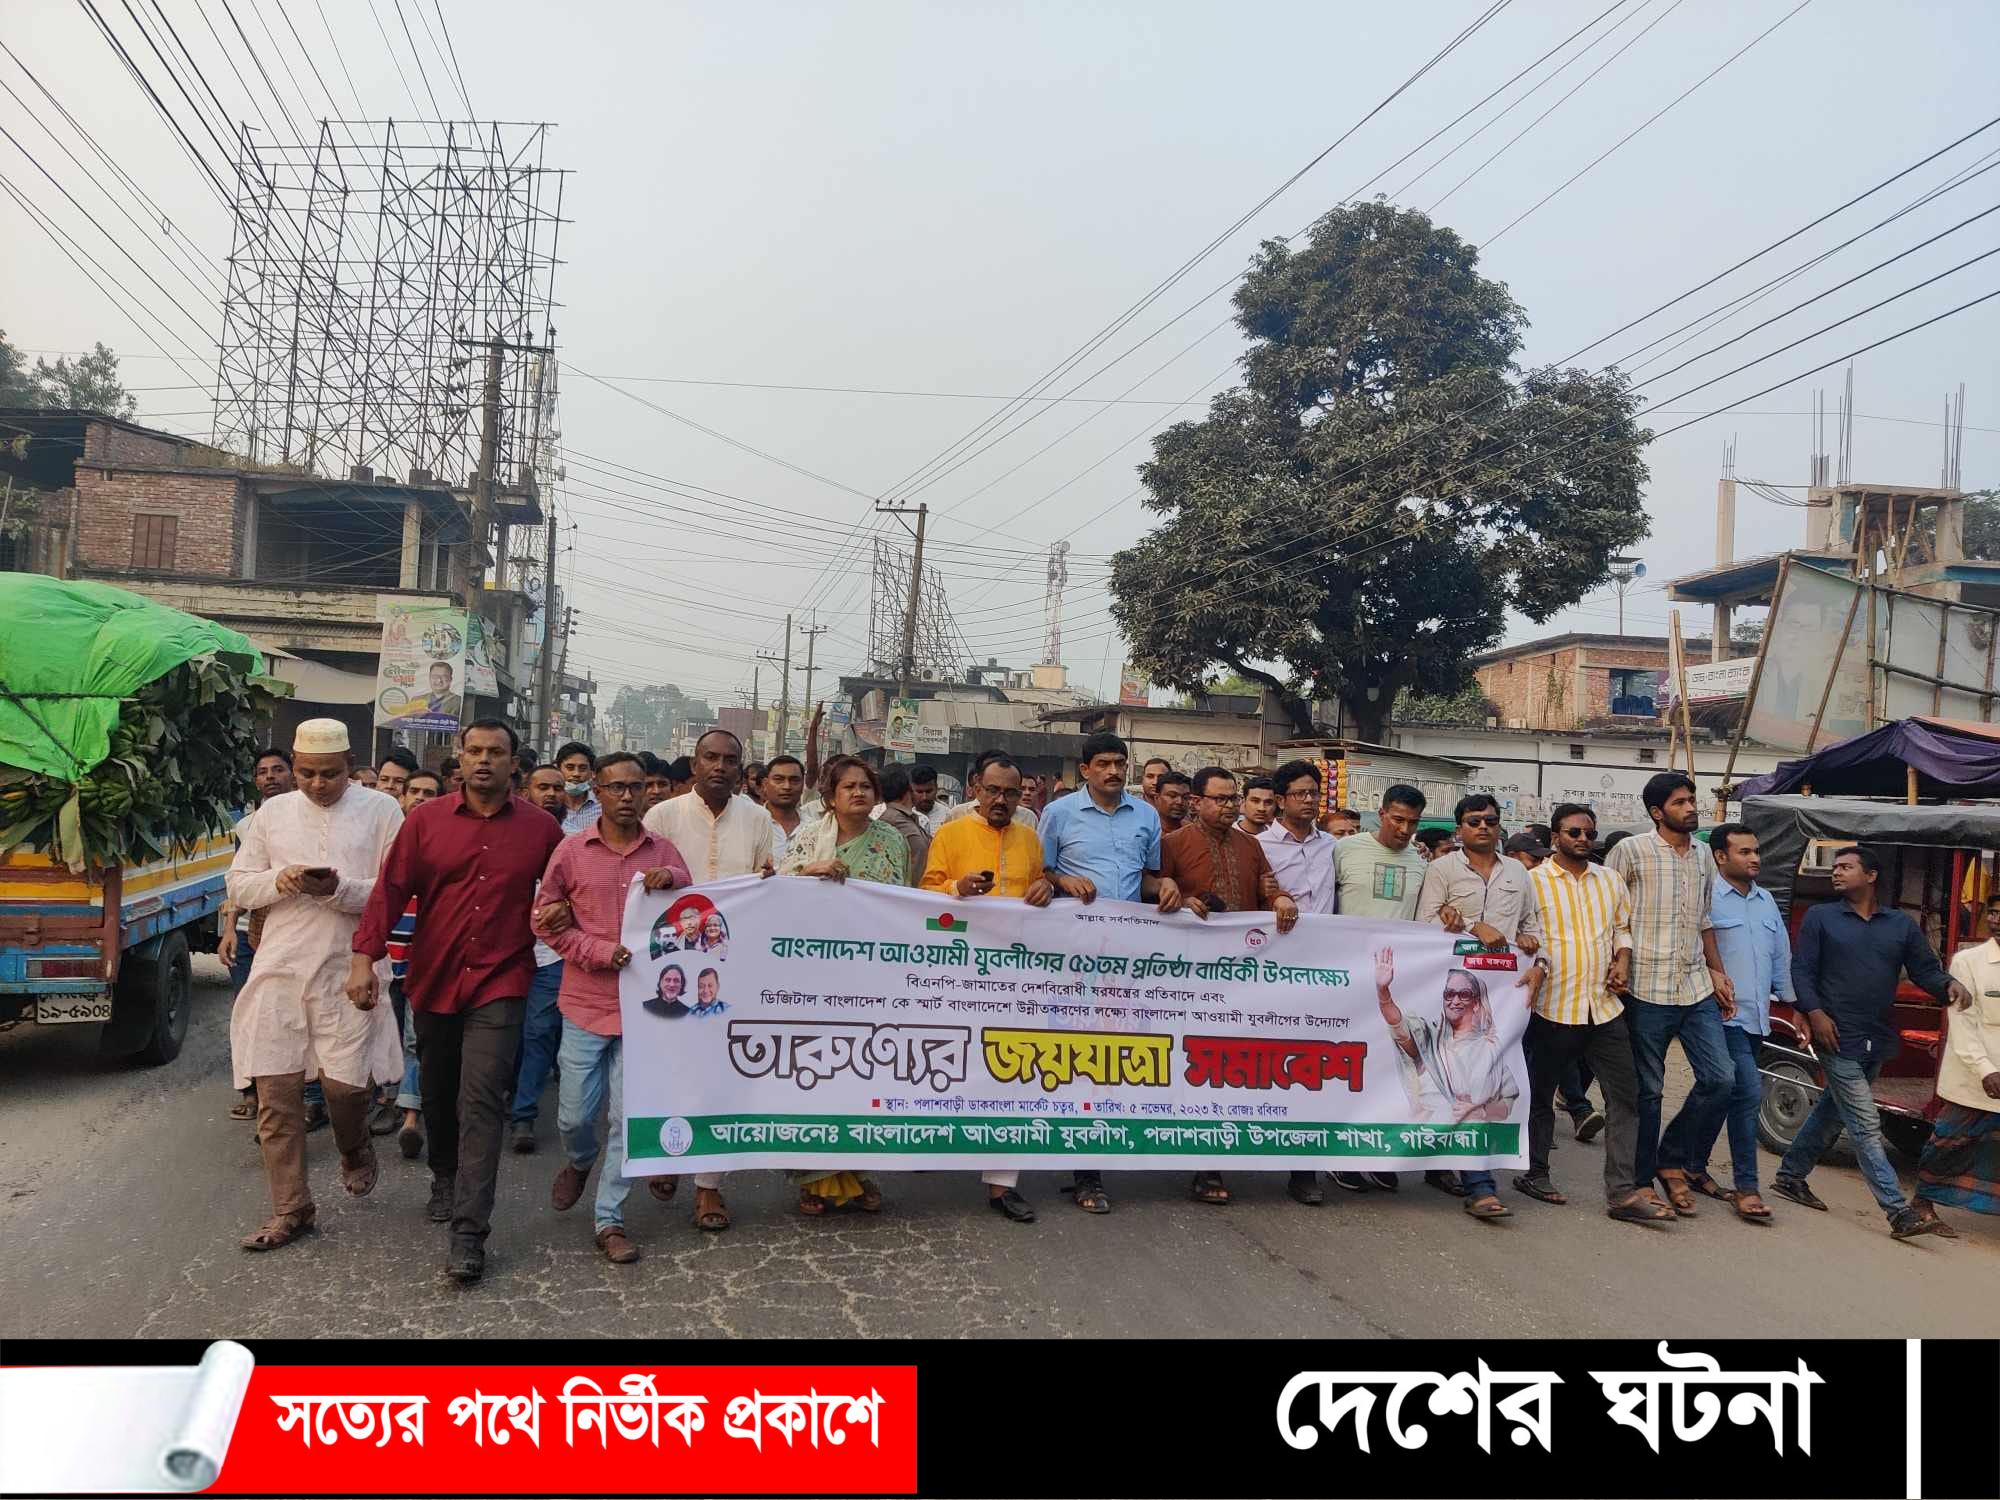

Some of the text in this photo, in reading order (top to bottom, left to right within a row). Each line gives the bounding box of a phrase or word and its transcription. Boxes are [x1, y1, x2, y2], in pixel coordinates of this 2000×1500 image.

[1075, 913, 1105, 923] আল্লাহ
[771, 937, 1350, 987] বাংলাদেশ আওয়ামী যুবলীগের ৫১তম প্রতিষ্ঠা বার্ষিকী উপলক্ষ্যে
[906, 974, 1226, 1004] বিএনপি-জামাতের দেশবিরোধী ষরযন্ত্রের প্রতিবাদে এবং
[760, 989, 1350, 1029] ডিজিটাল বাংলাদেশ কে স্মার্ট বাংলাদেশে উন্নীতকরণের লক্ষ্যে বাংলাদেশ আওয়ামী যুবলীগের উদ্যোগে
[727, 1018, 1368, 1092] তারুণ্যের জয়যাত্রা সমাবেশ
[885, 1097, 909, 1112] স্থান:
[914, 1095, 965, 1113] পলাশবাড়ী
[968, 1098, 1015, 1111] ডাকবাংলা
[1018, 1096, 1049, 1112] মার্কেট
[1093, 1098, 1125, 1114] তারিখ:
[1129, 1103, 1137, 1114] ৫
[1141, 1102, 1176, 1116] নভেম্বর,
[1180, 1103, 1208, 1115] ২০২৩
[1212, 1102, 1223, 1115] ইং
[1257, 1103, 1289, 1116] রবিবার
[709, 1121, 839, 1146] আয়োজনেঃ
[848, 1121, 955, 1147] বাংলাদেশ
[960, 1119, 1054, 1146] আওয়ামী
[1058, 1121, 1135, 1151] যুবলীগ,
[1143, 1121, 1241, 1151] পলাশবাড়ী
[1247, 1123, 1328, 1149] উপজেলা
[1336, 1125, 1392, 1153] শাখা,
